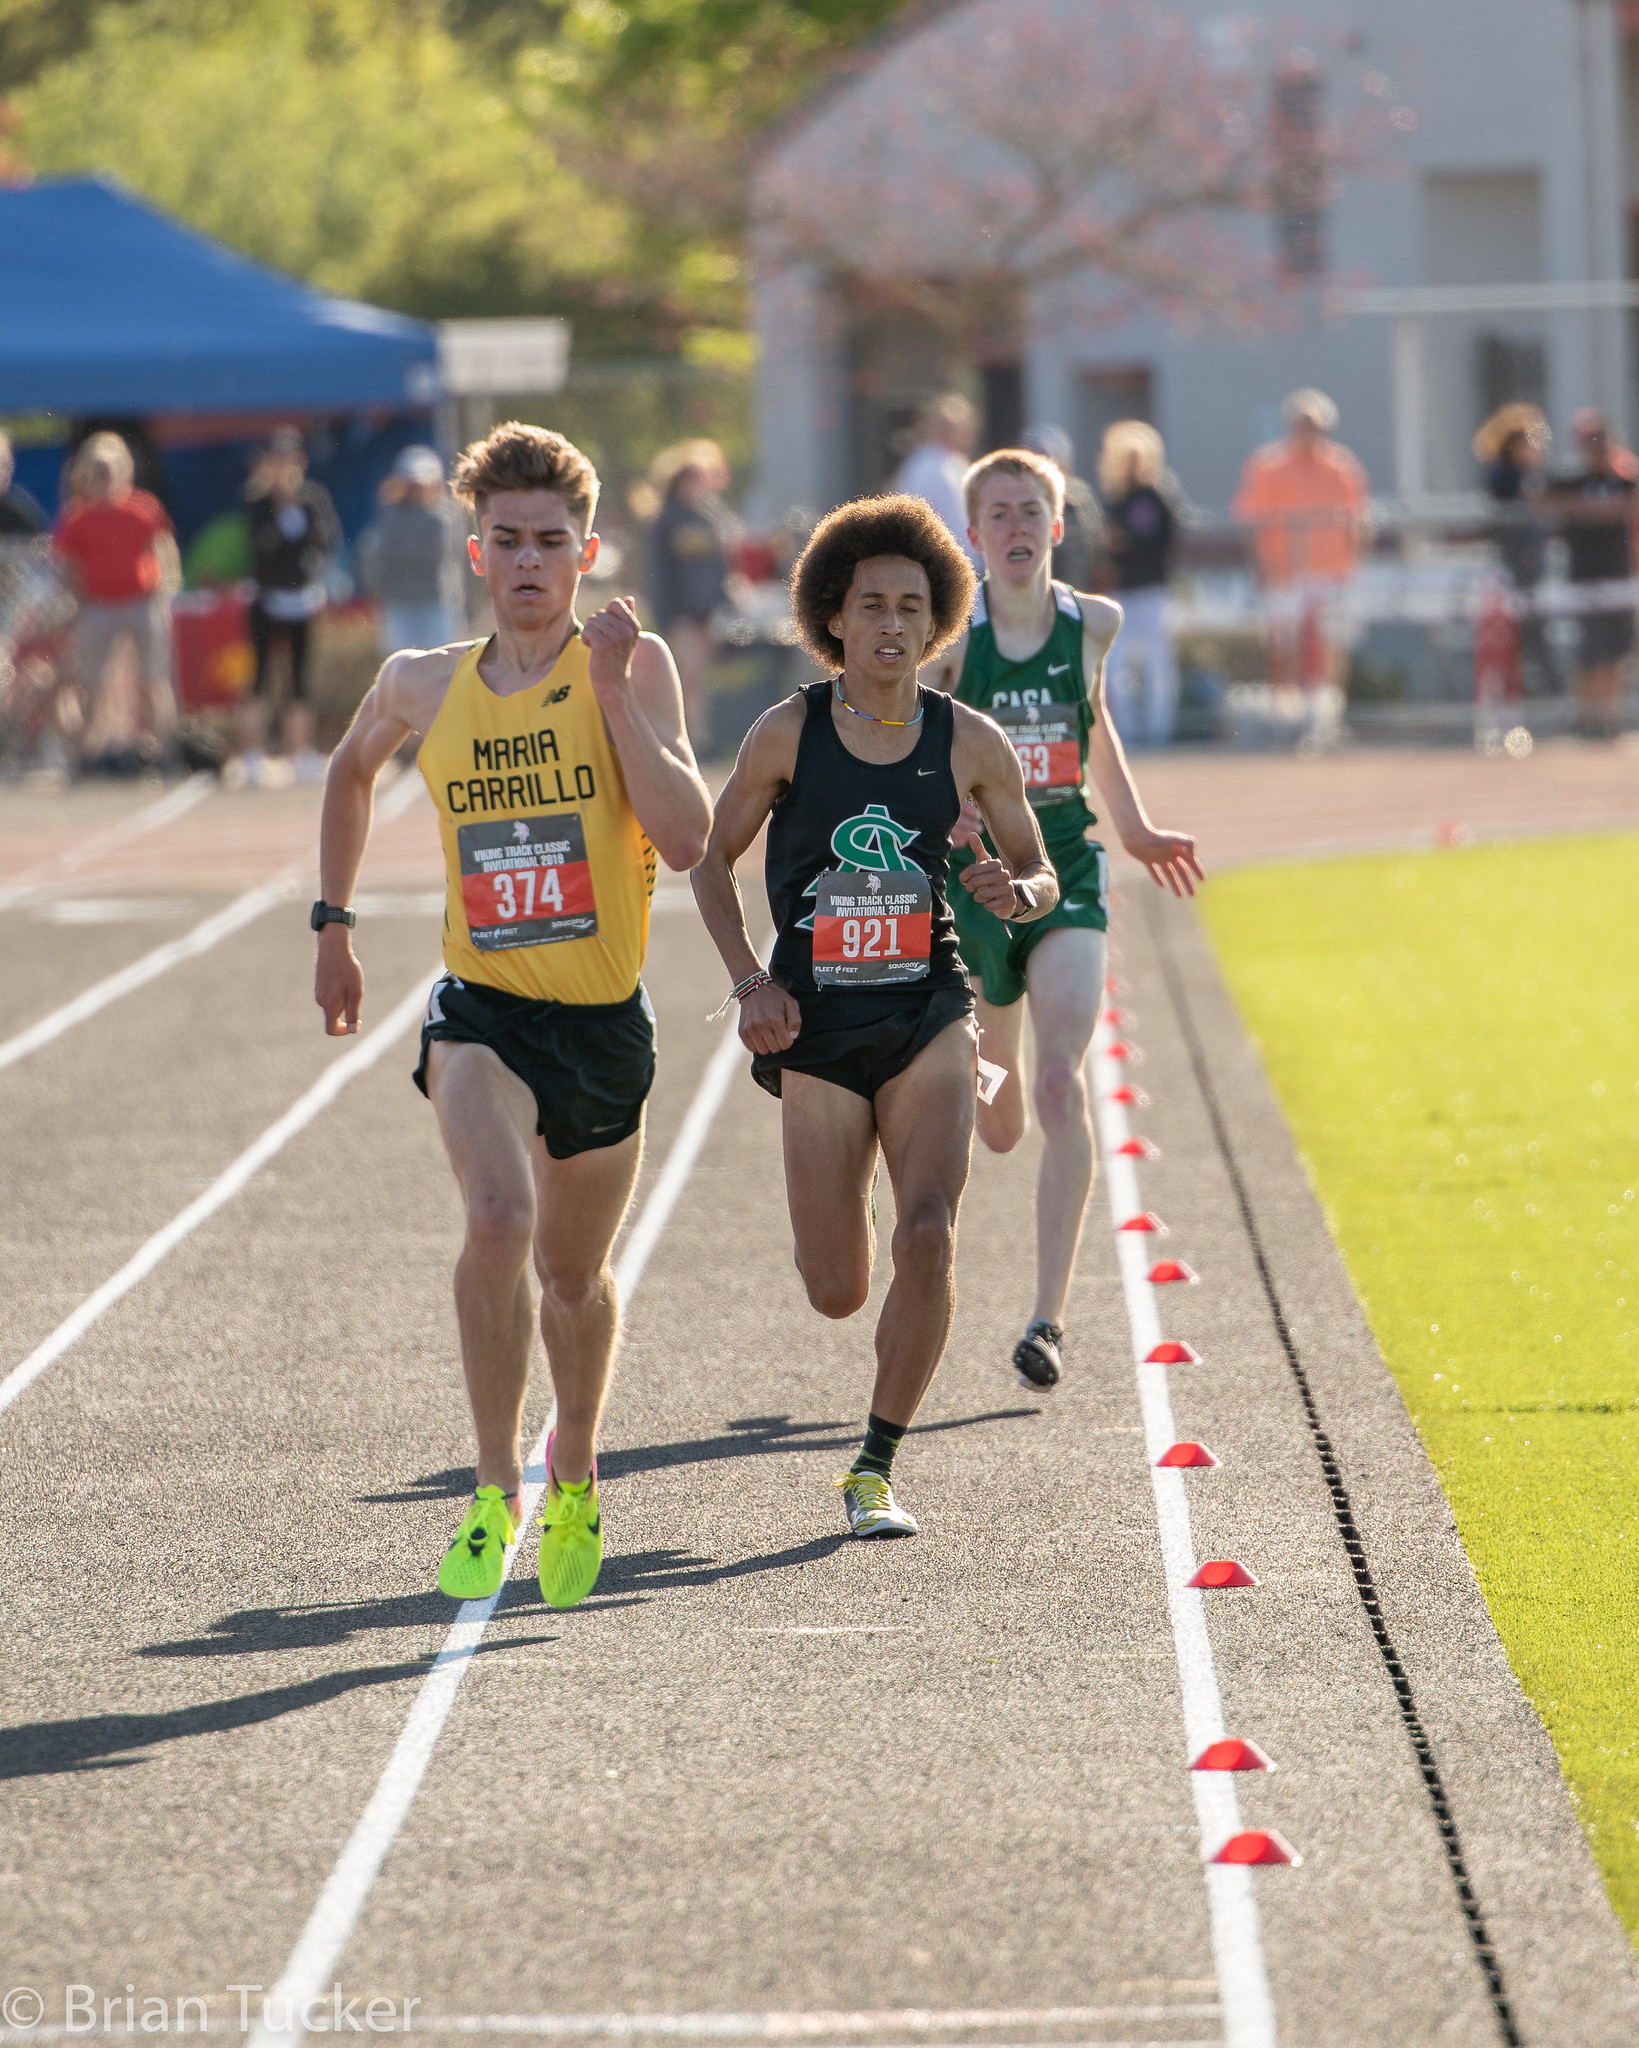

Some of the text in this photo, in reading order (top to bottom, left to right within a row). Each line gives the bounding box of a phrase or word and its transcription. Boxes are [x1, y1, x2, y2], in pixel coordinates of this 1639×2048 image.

[473, 728, 560, 771] MARIA
[447, 764, 595, 813] CARRILLO
[474, 840, 571, 862] VIKING TRACK CLASSIC
[483, 853, 565, 872] INVITATIONAL 2019
[493, 868, 564, 918] 374
[830, 893, 918, 907] VIKING TRACK CLASSIC
[836, 905, 910, 917] INVITATIONAL 2019
[842, 918, 901, 958] 921
